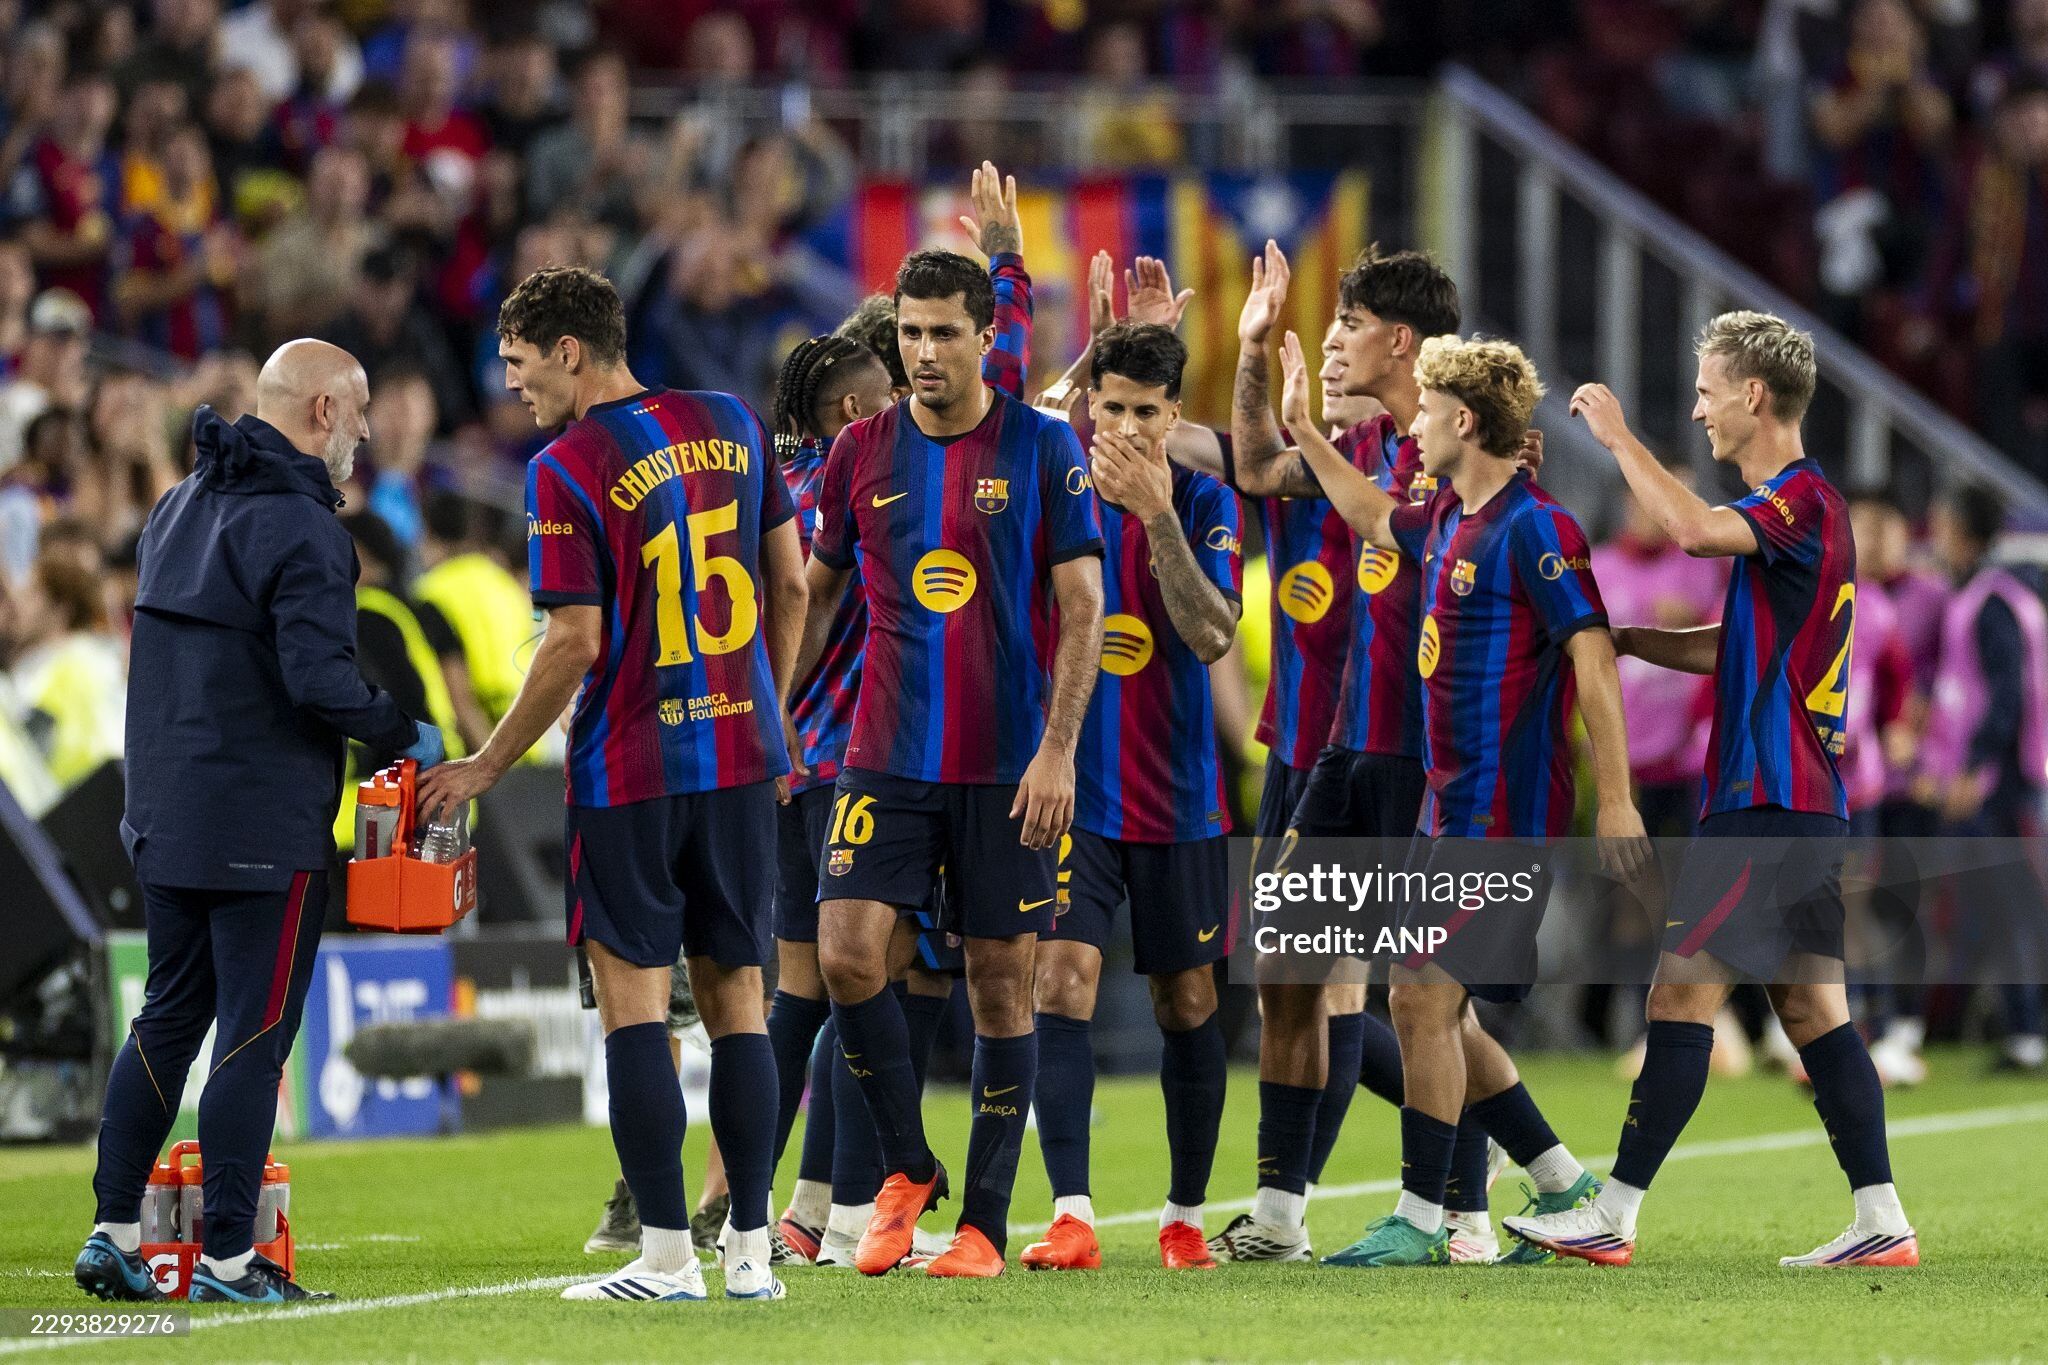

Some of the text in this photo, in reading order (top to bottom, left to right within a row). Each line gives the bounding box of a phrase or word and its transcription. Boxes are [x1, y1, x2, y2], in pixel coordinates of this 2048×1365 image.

[609, 438, 749, 512] CHRISTENSEN
[526, 511, 573, 542] Midea
[1752, 484, 1795, 526] Midea
[640, 499, 758, 668] 15
[1805, 582, 1855, 718] 2
[687, 692, 729, 710] BARÇA
[828, 792, 879, 845] 16
[979, 1103, 1018, 1117] BARÇA
